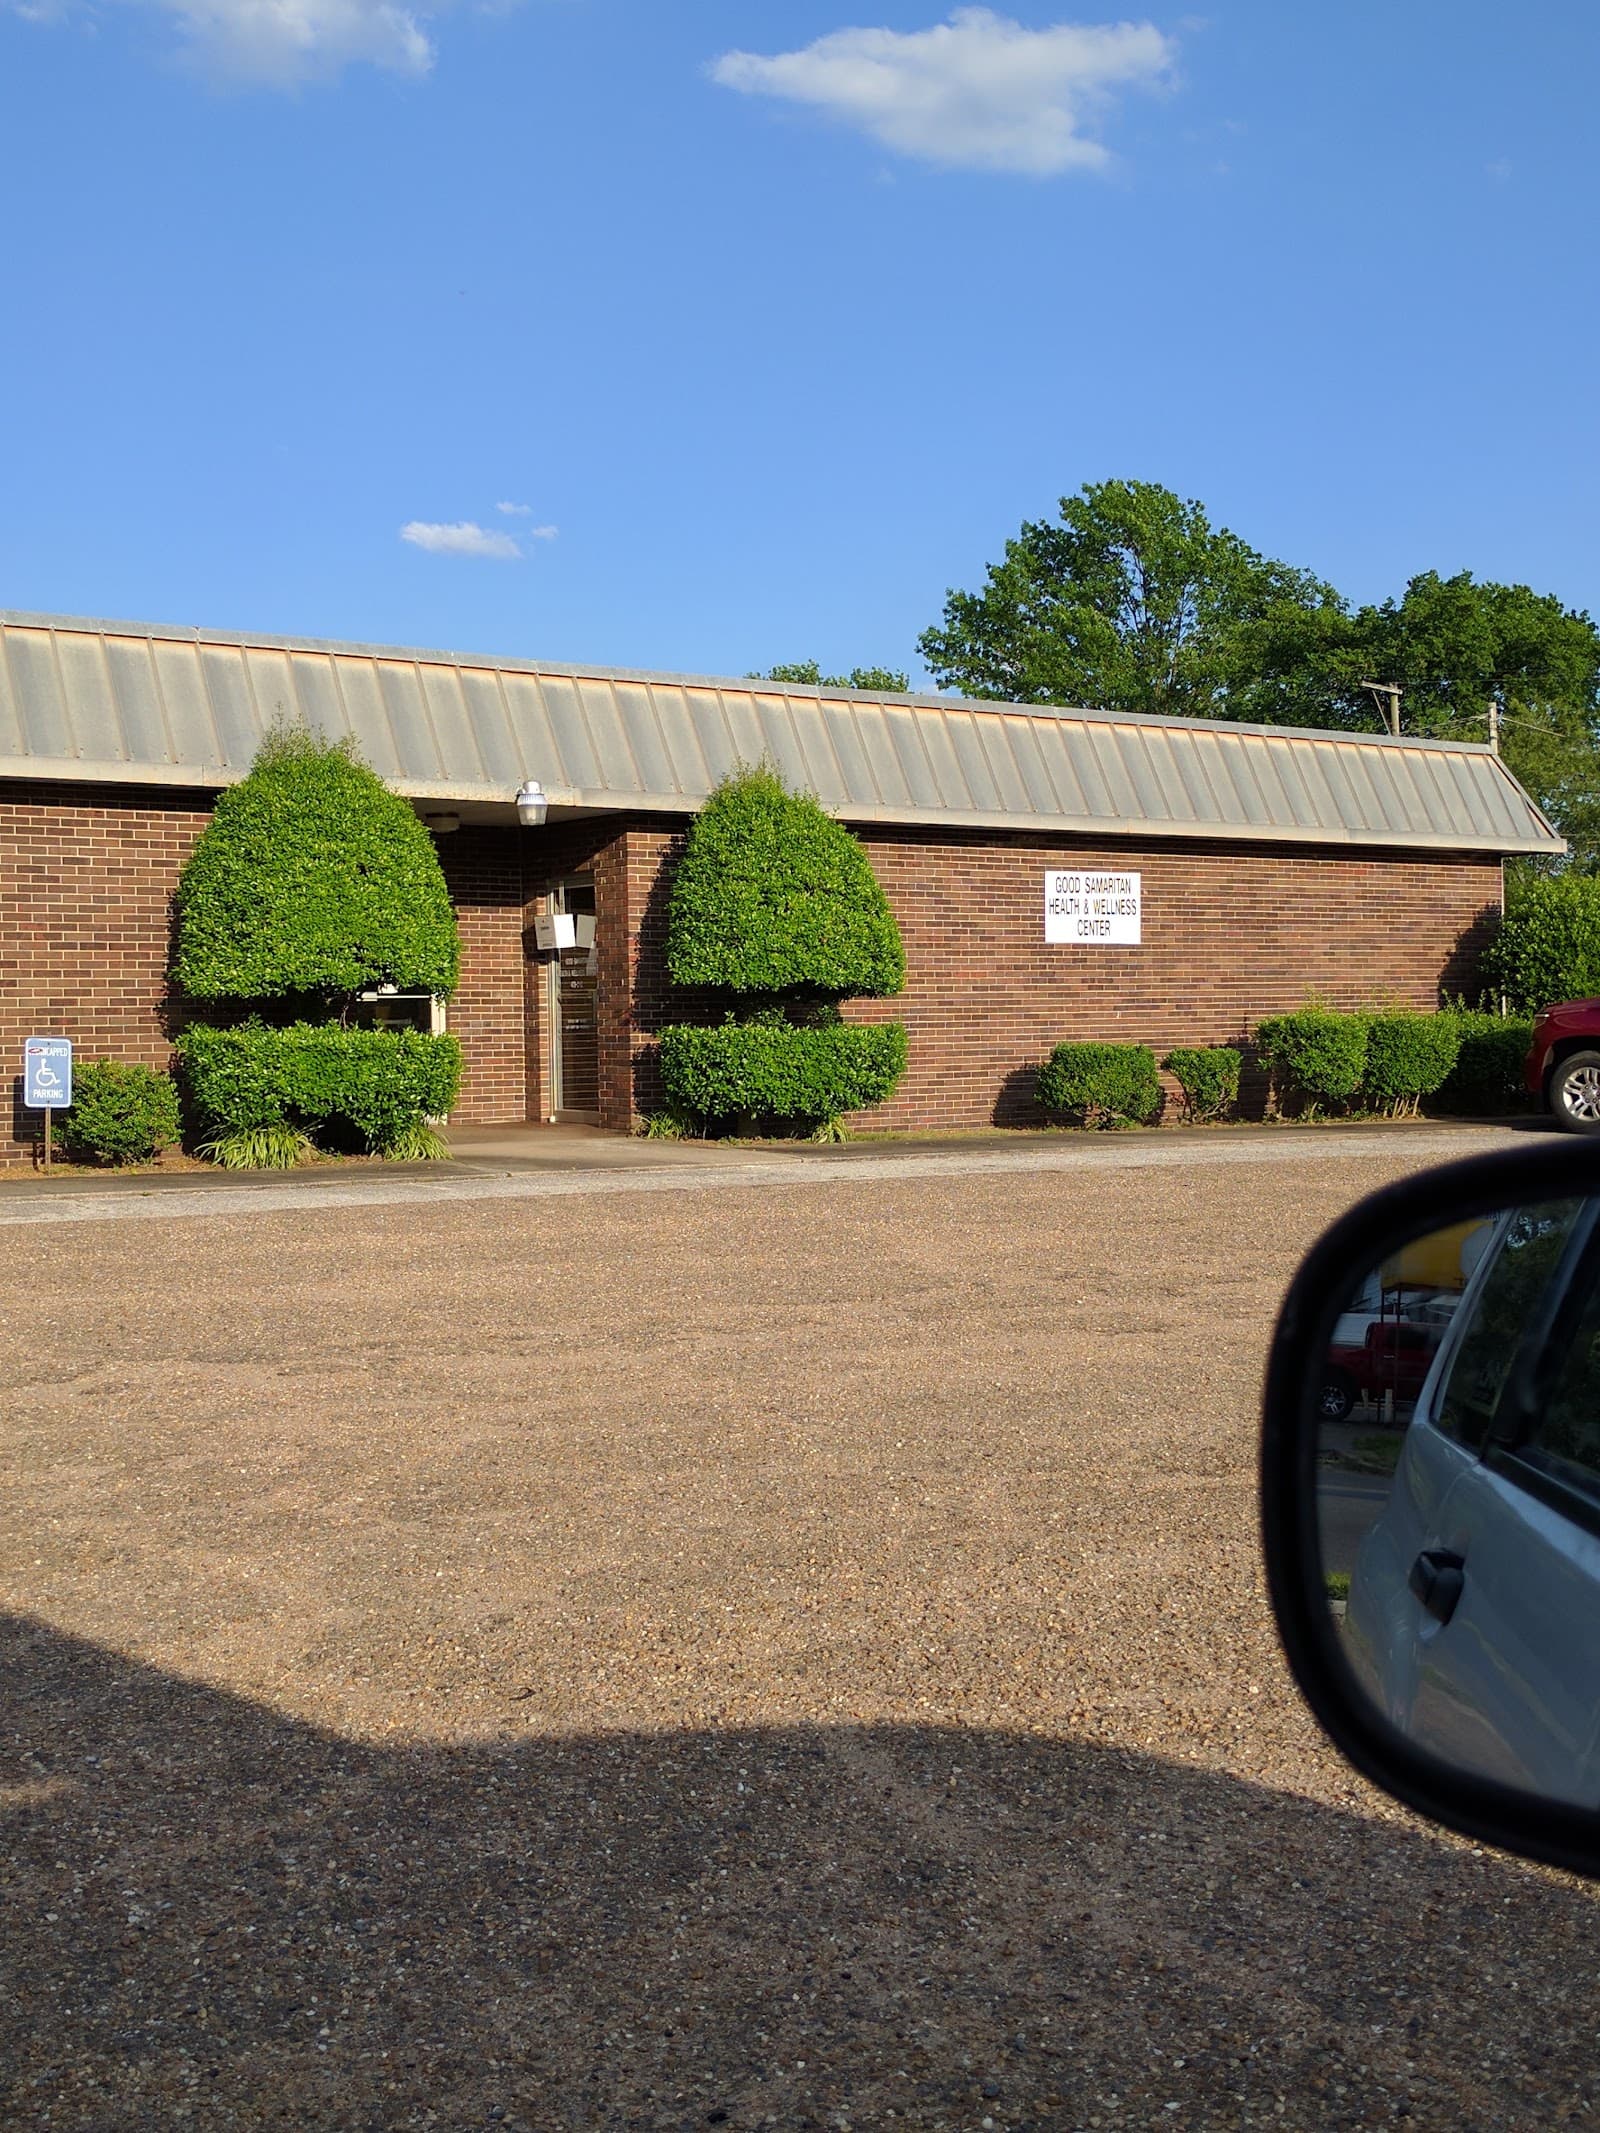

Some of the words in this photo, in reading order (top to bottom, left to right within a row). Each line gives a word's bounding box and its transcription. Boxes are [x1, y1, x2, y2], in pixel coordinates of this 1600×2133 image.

[1056, 876, 1080, 893] GOOD
[1085, 877, 1131, 894] SAMARITAN
[1049, 898, 1080, 915] HEALTH
[1083, 899, 1089, 915] &
[1093, 899, 1137, 915] WELLNESS
[1077, 919, 1111, 936] CENTER
[33, 1088, 64, 1099] PARKING
